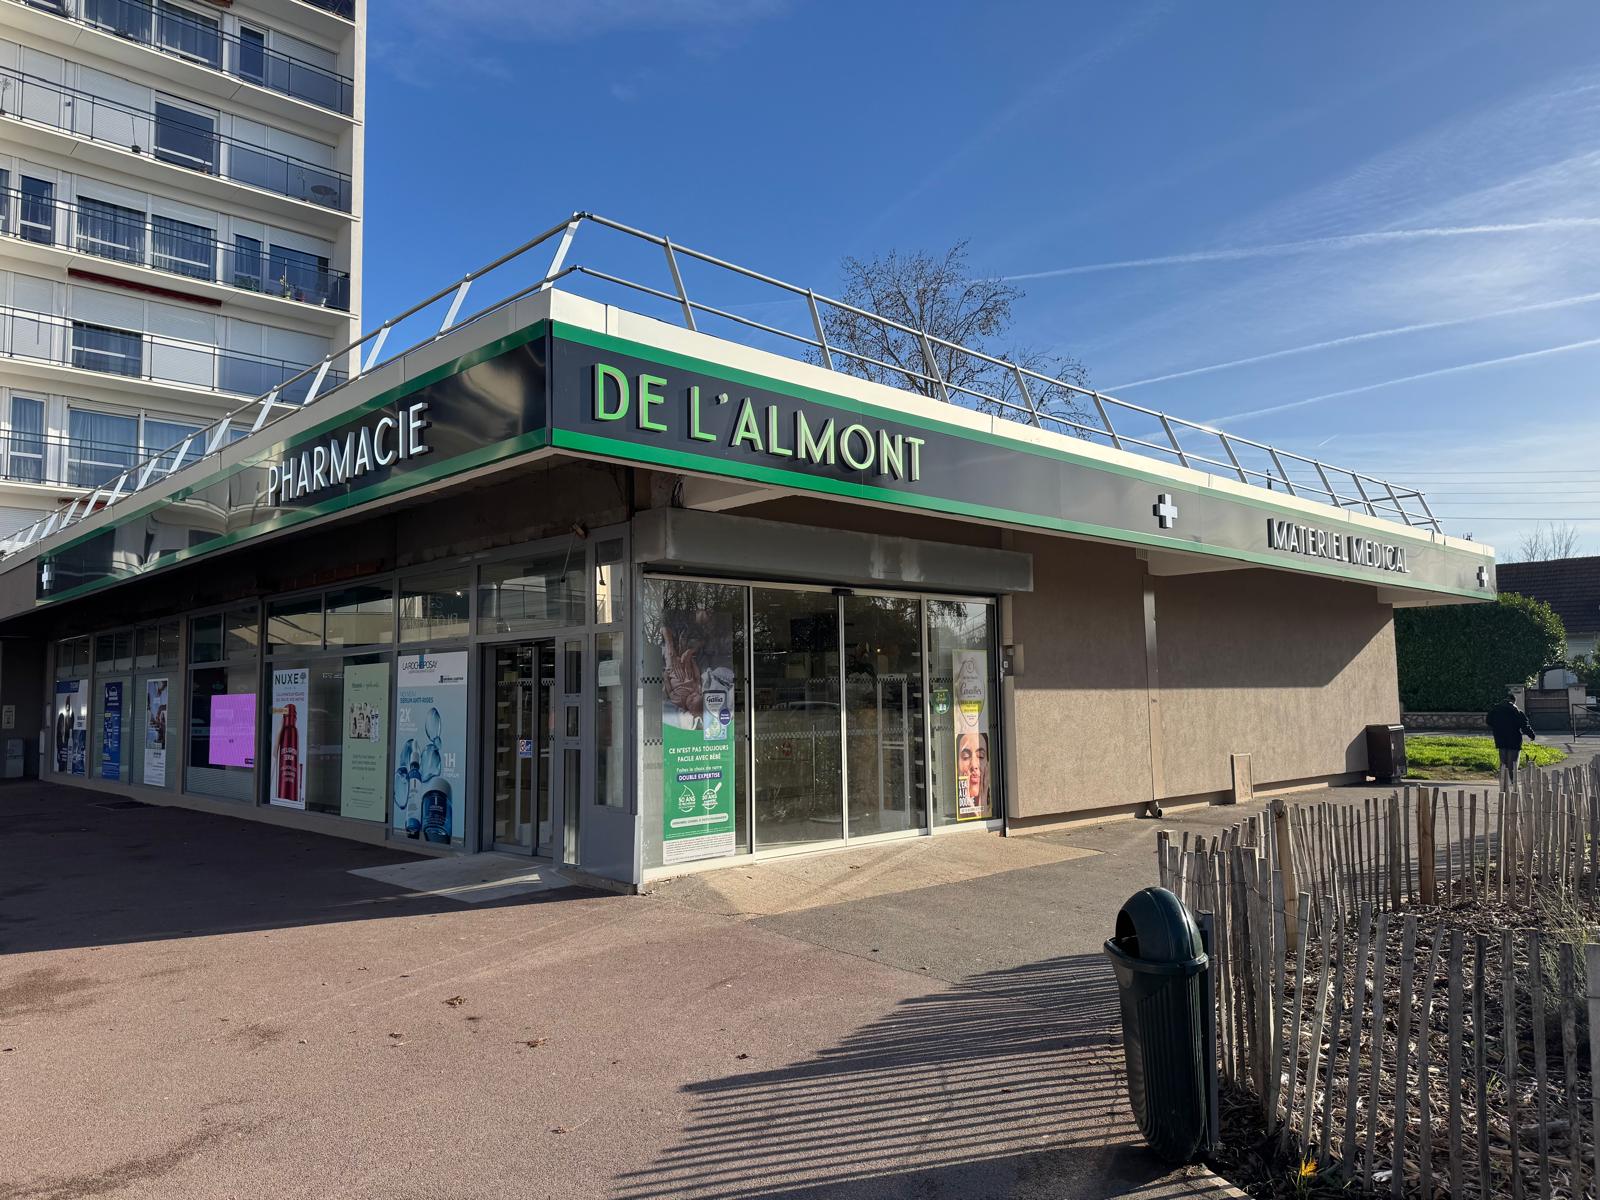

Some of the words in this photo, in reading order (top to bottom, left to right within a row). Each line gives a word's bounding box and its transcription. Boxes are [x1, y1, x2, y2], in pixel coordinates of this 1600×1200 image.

[594, 362, 668, 432] DE
[689, 385, 926, 482] L'ALMONT
[268, 402, 429, 507] PHARMACIE
[1268, 518, 1350, 563] MATERIEL
[1351, 536, 1411, 574] MEDICAL
[274, 673, 299, 685] NUXE
[400, 707, 411, 722] 2X
[702, 744, 729, 752] TOUJOURS
[444, 752, 456, 768] 1H
[678, 773, 697, 781] DOUBLE
[697, 771, 720, 780] EXPERTISE
